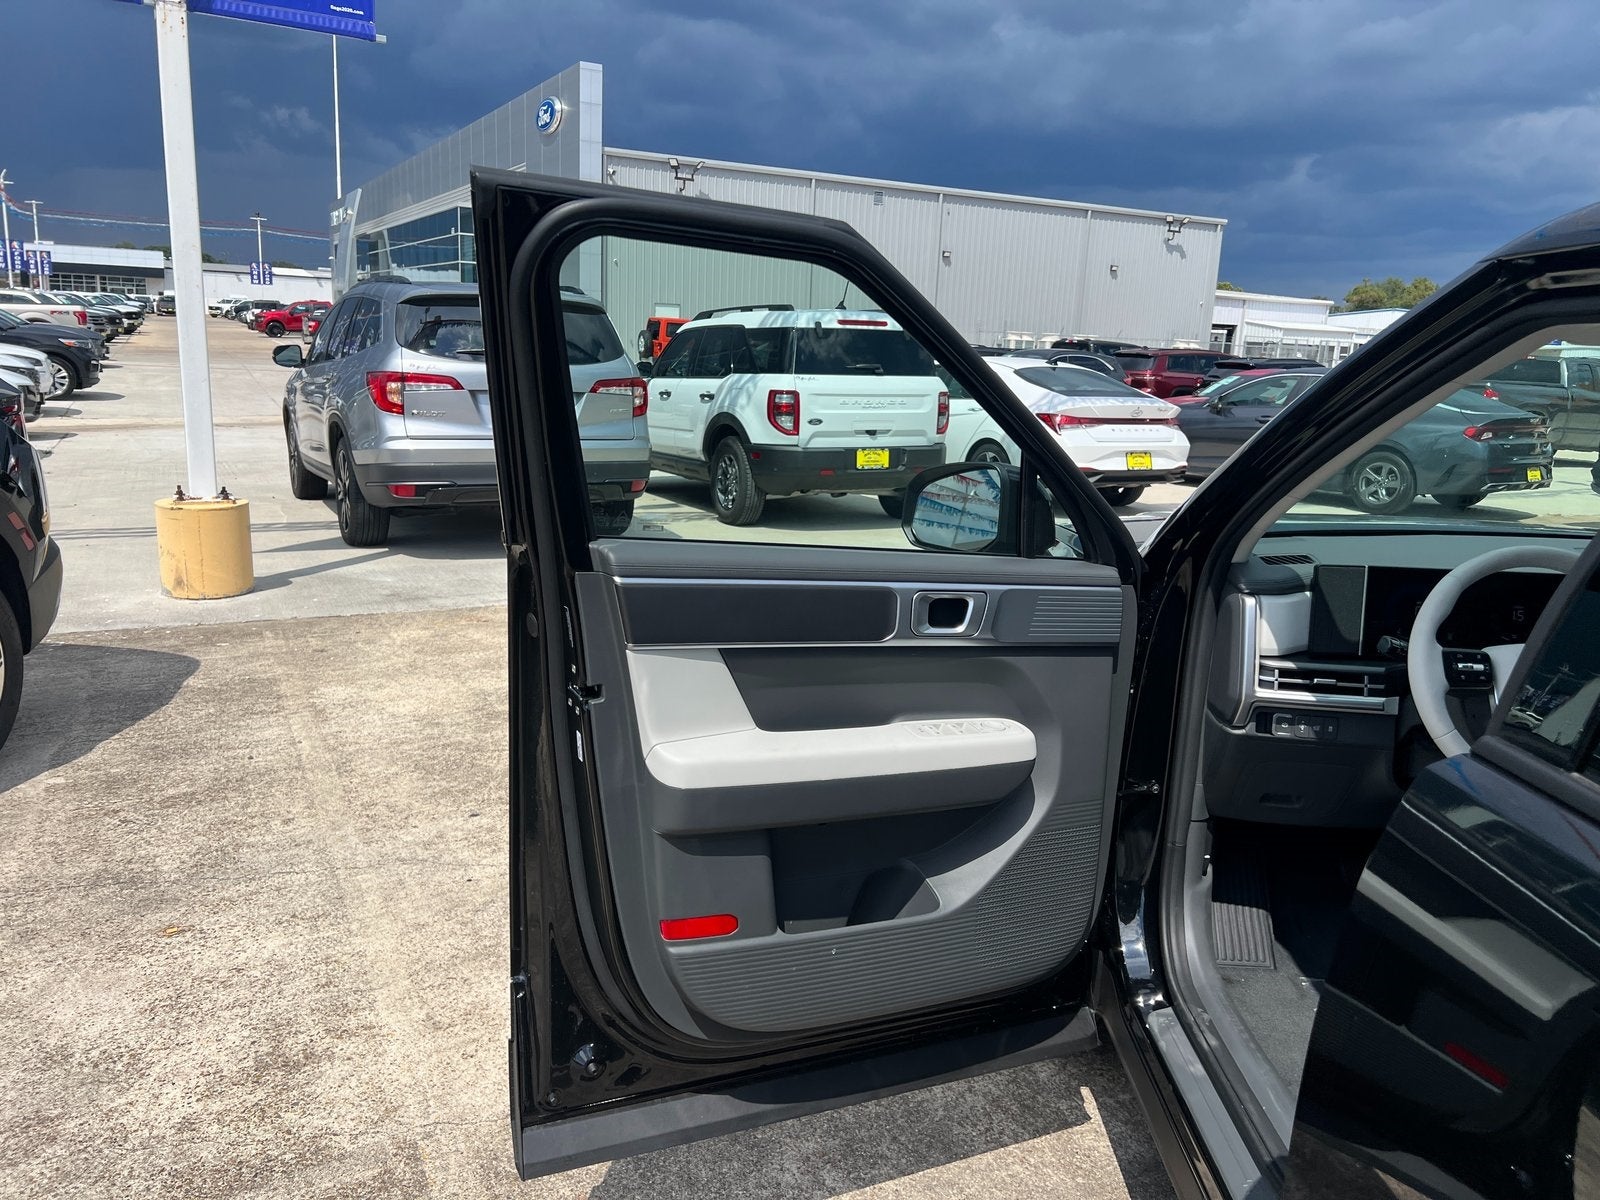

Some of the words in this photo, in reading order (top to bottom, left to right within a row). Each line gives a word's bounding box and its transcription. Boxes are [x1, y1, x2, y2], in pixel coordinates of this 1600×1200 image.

[537, 102, 552, 128] Ford
[29, 259, 37, 274] NEW
[411, 409, 447, 418] PILOT
